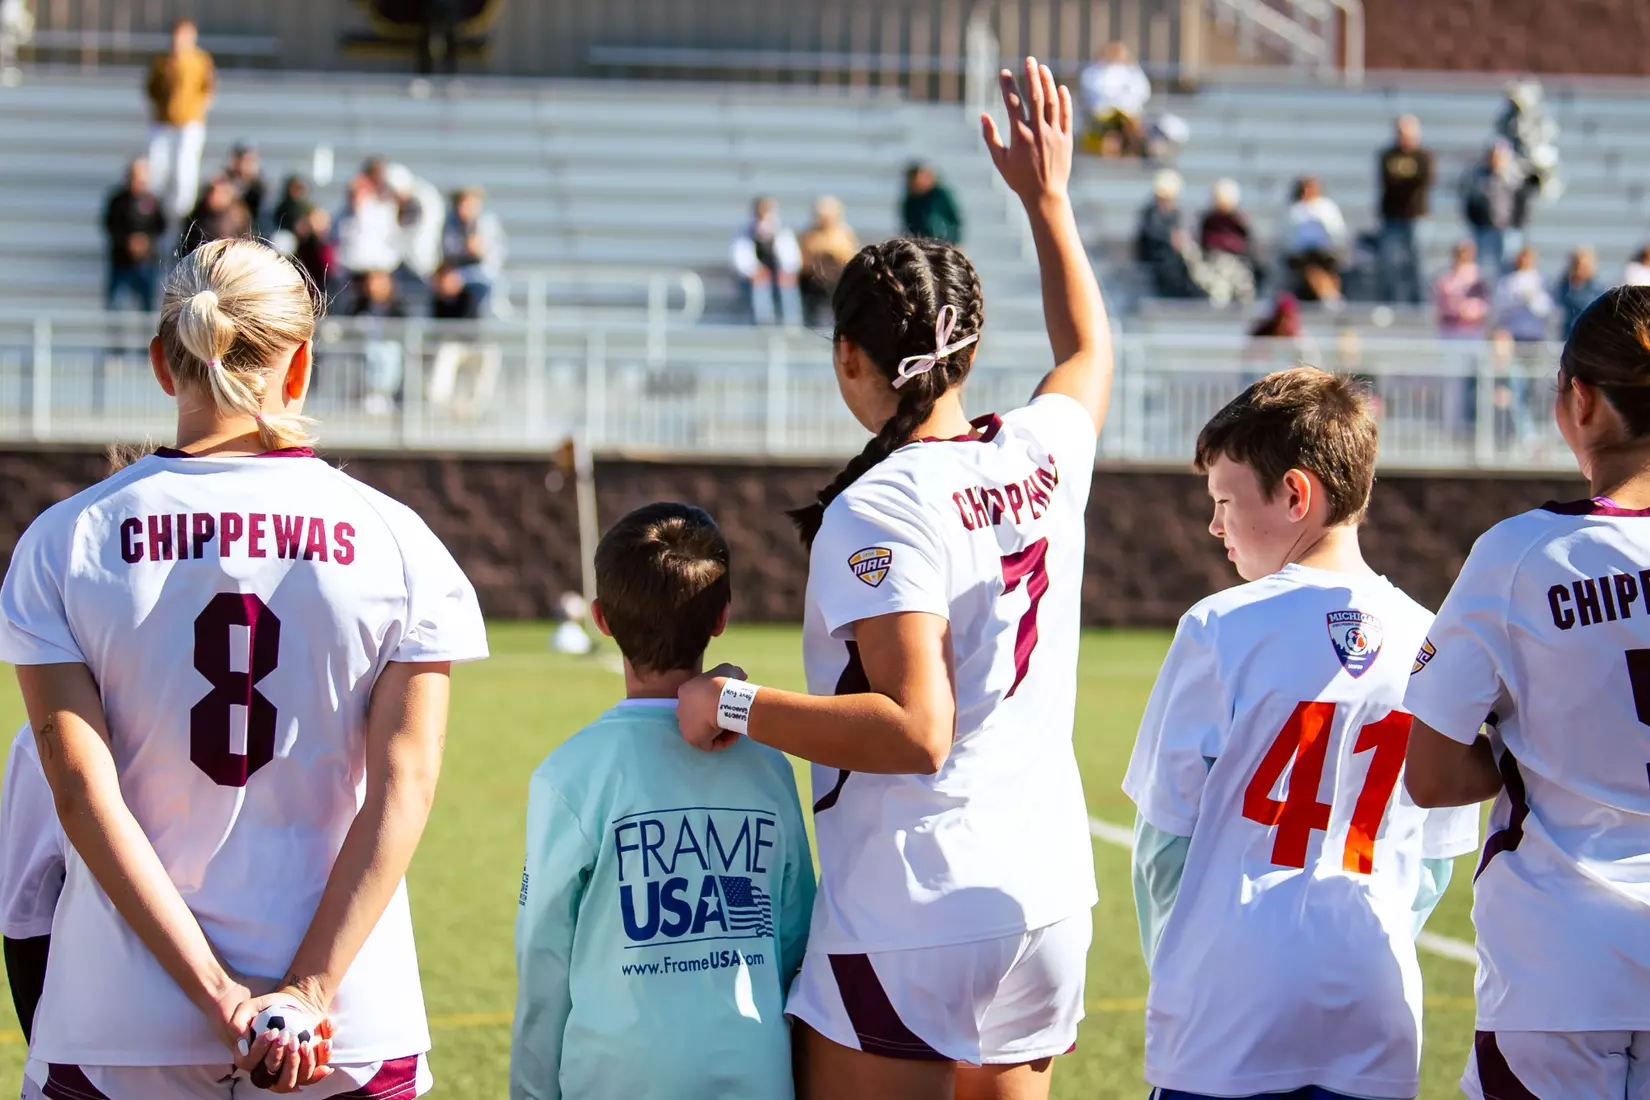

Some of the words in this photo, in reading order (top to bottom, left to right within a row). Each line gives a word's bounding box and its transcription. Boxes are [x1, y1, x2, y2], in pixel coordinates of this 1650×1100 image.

[120, 512, 355, 565] CHIPPEWAS
[854, 557, 890, 575] MAC
[1000, 536, 1050, 702] 7
[190, 592, 281, 787] 8
[1242, 701, 1414, 875] 41
[615, 814, 775, 881] FRAME
[620, 875, 728, 941] USA
[622, 950, 764, 976] www.FrameUSA.om
